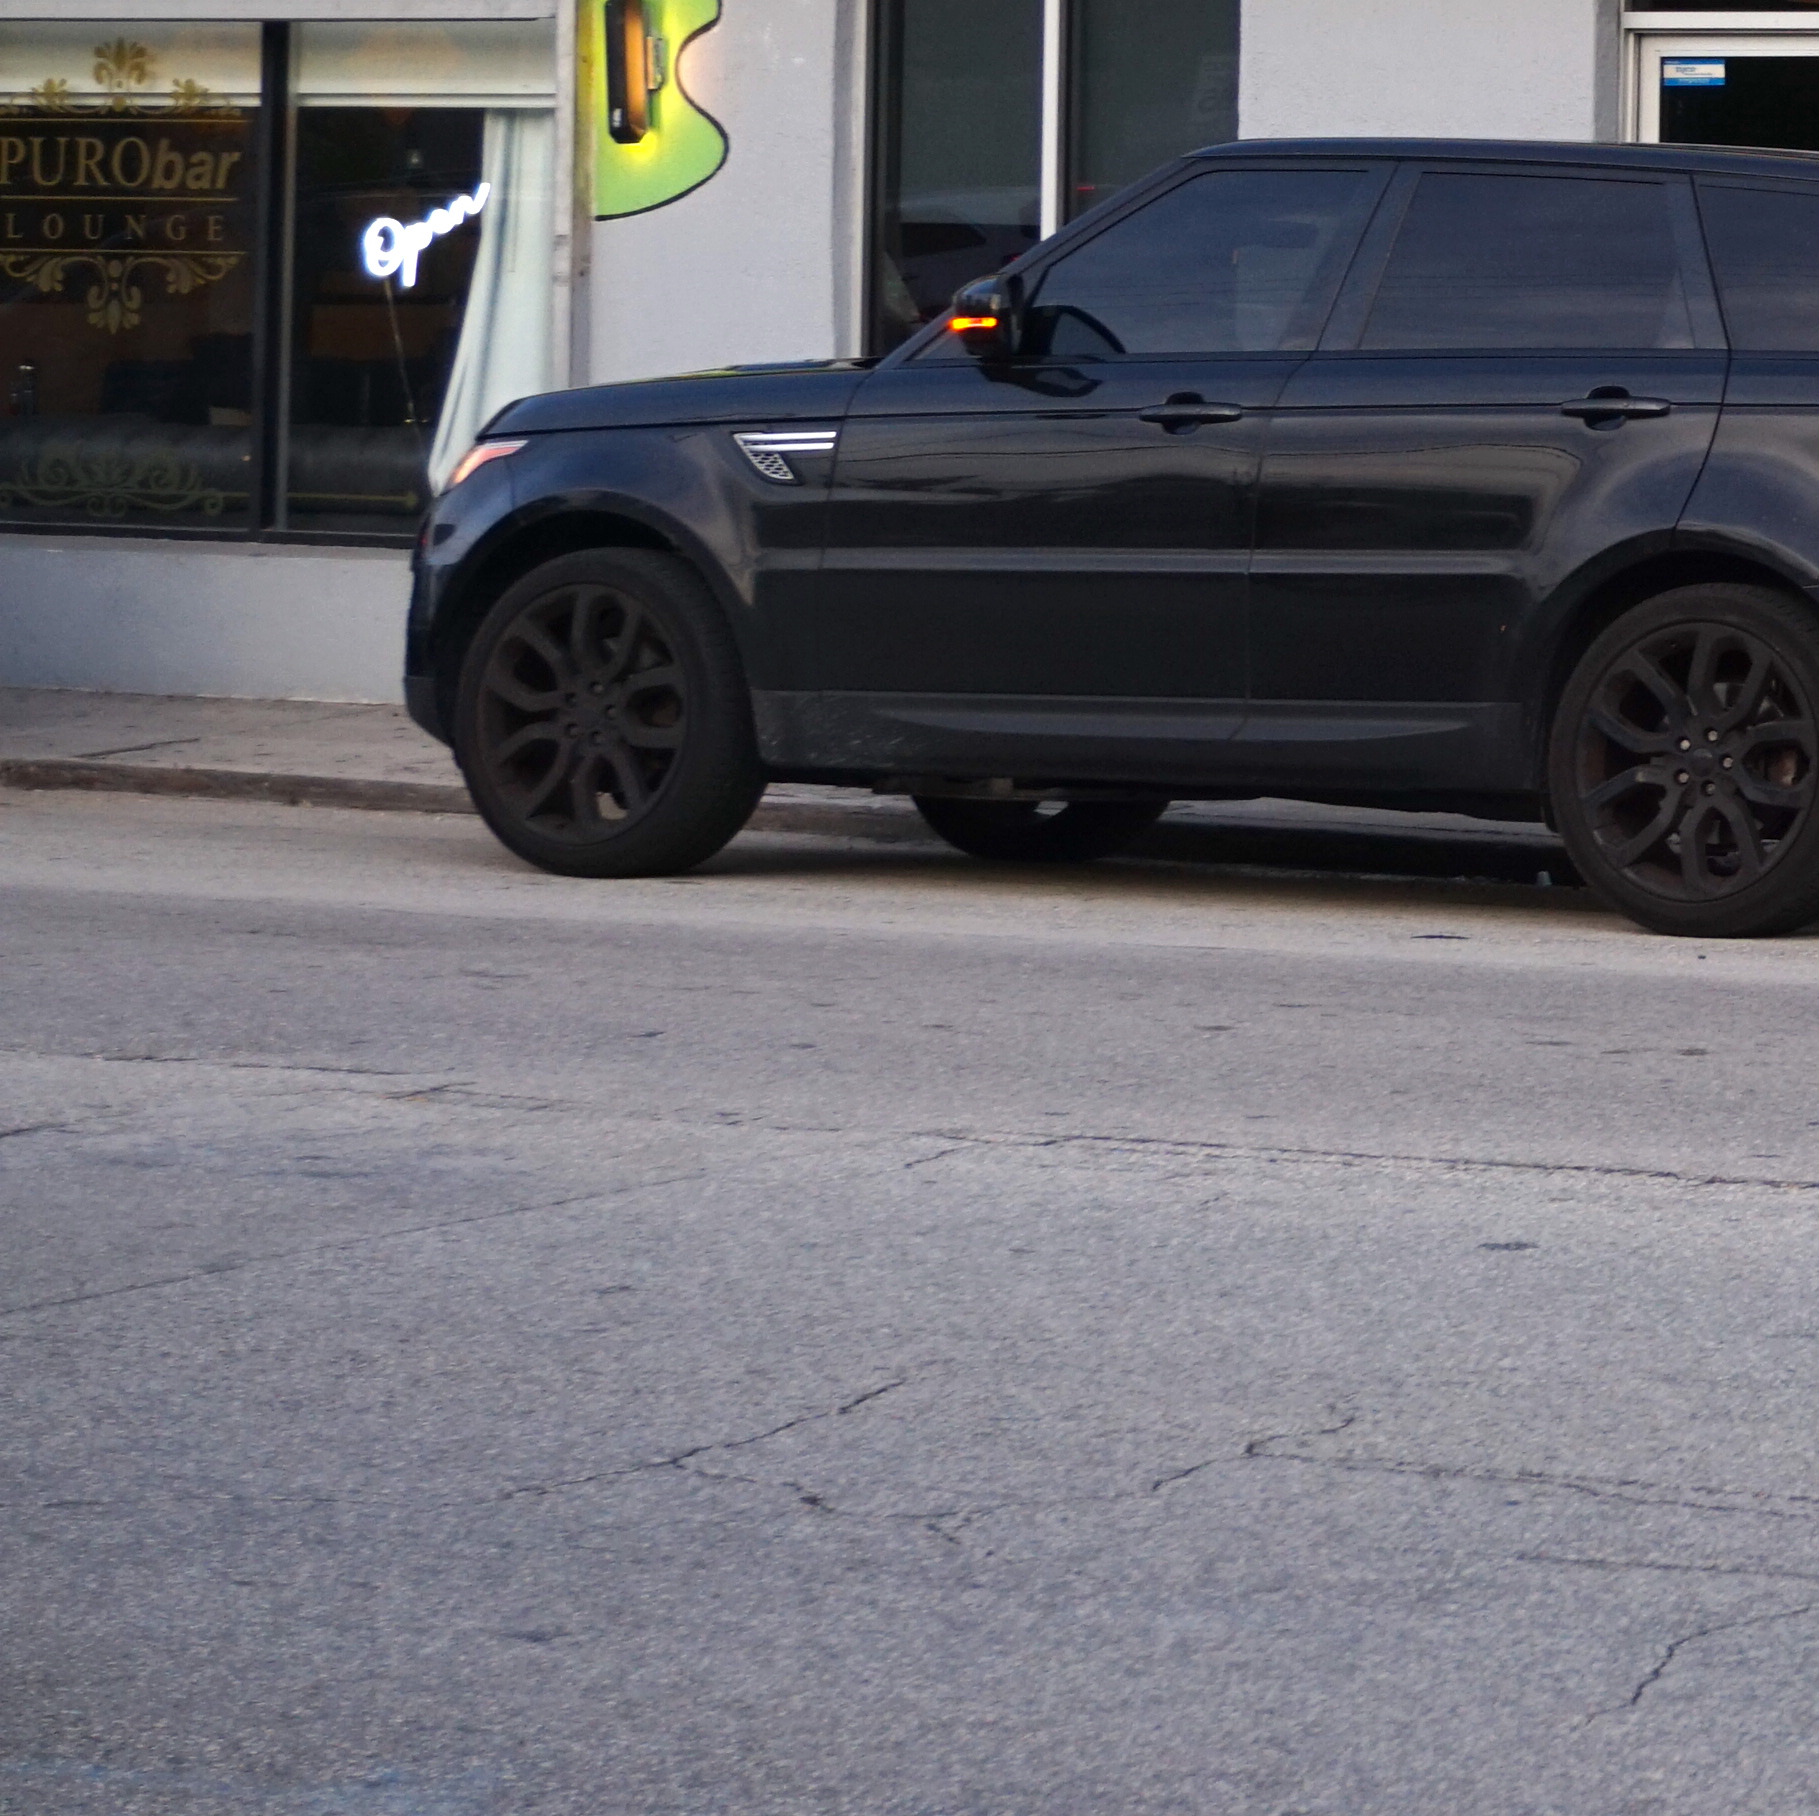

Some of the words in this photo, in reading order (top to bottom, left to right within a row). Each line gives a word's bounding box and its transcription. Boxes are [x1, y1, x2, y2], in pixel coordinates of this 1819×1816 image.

[0, 137, 242, 190] PURObar
[5, 213, 224, 241] LOUNGE
[363, 181, 491, 287] Open
